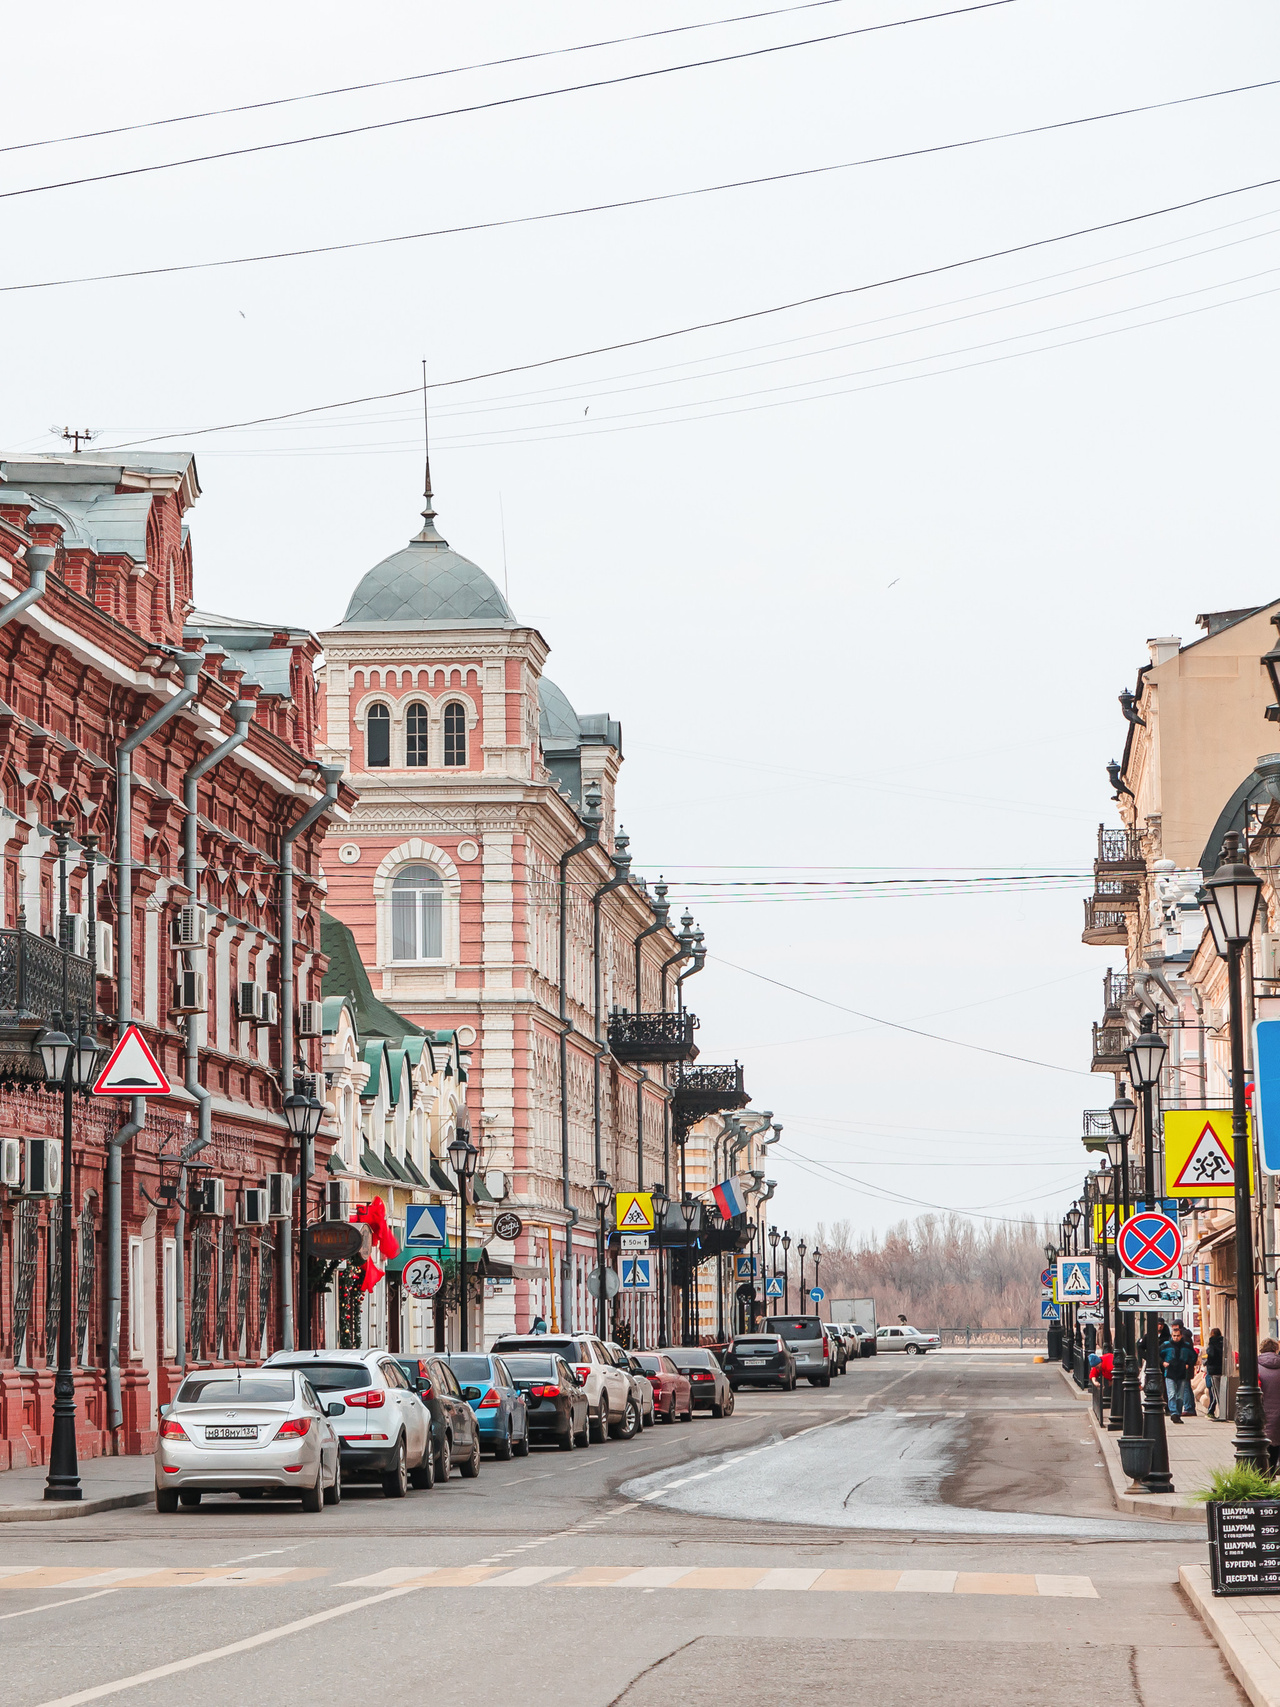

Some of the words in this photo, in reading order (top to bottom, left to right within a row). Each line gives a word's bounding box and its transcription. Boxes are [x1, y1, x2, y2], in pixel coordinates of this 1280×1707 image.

[242, 1427, 255, 1435] 134
[1223, 1524, 1256, 1532] ШАУРМА
[1225, 1560, 1257, 1568] БУРГЕРЫ
[1226, 1574, 1258, 1583] ДЕСЕРТЫ
